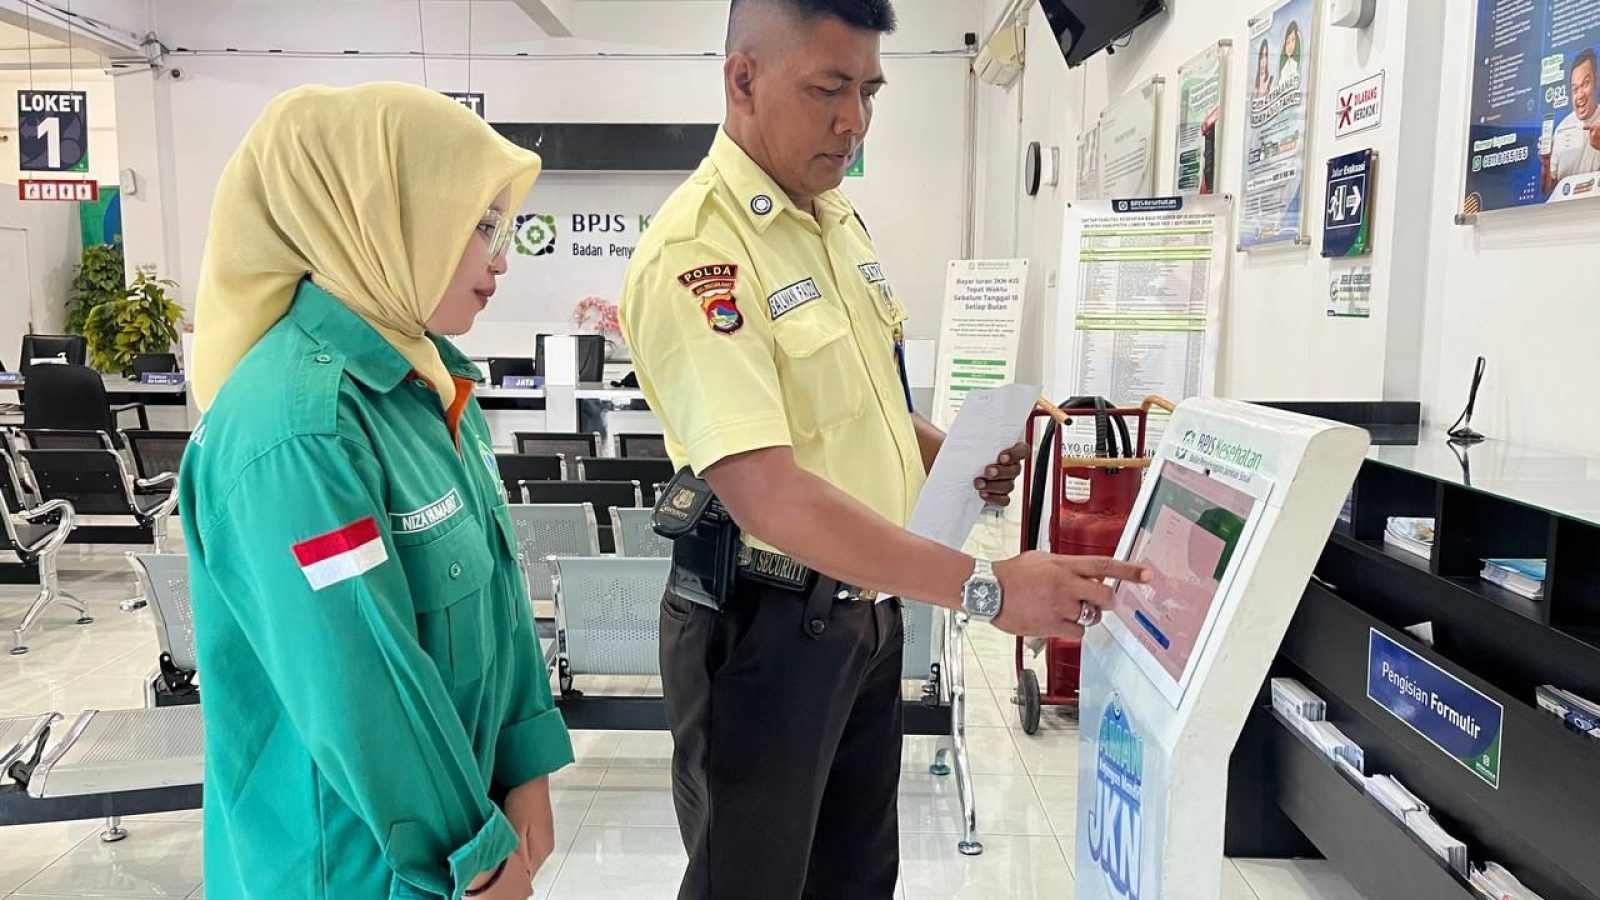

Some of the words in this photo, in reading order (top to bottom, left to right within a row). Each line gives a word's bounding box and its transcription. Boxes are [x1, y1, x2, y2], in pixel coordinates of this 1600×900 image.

[20, 94, 83, 112] LOKET
[1354, 86, 1377, 106] DILARANG
[37, 117, 61, 168] 1
[572, 213, 626, 233] BPJS
[572, 243, 603, 257] Badan
[609, 243, 635, 259] Peny
[684, 265, 731, 282] POLDA
[983, 294, 1010, 302] Tanggal
[1215, 439, 1263, 470] Kesehatan
[402, 512, 429, 531] NIZA
[757, 551, 803, 582] SECURITY
[1382, 661, 1429, 706] Pengisian
[1430, 692, 1481, 740] Formulir
[1089, 779, 1142, 900] JKN
